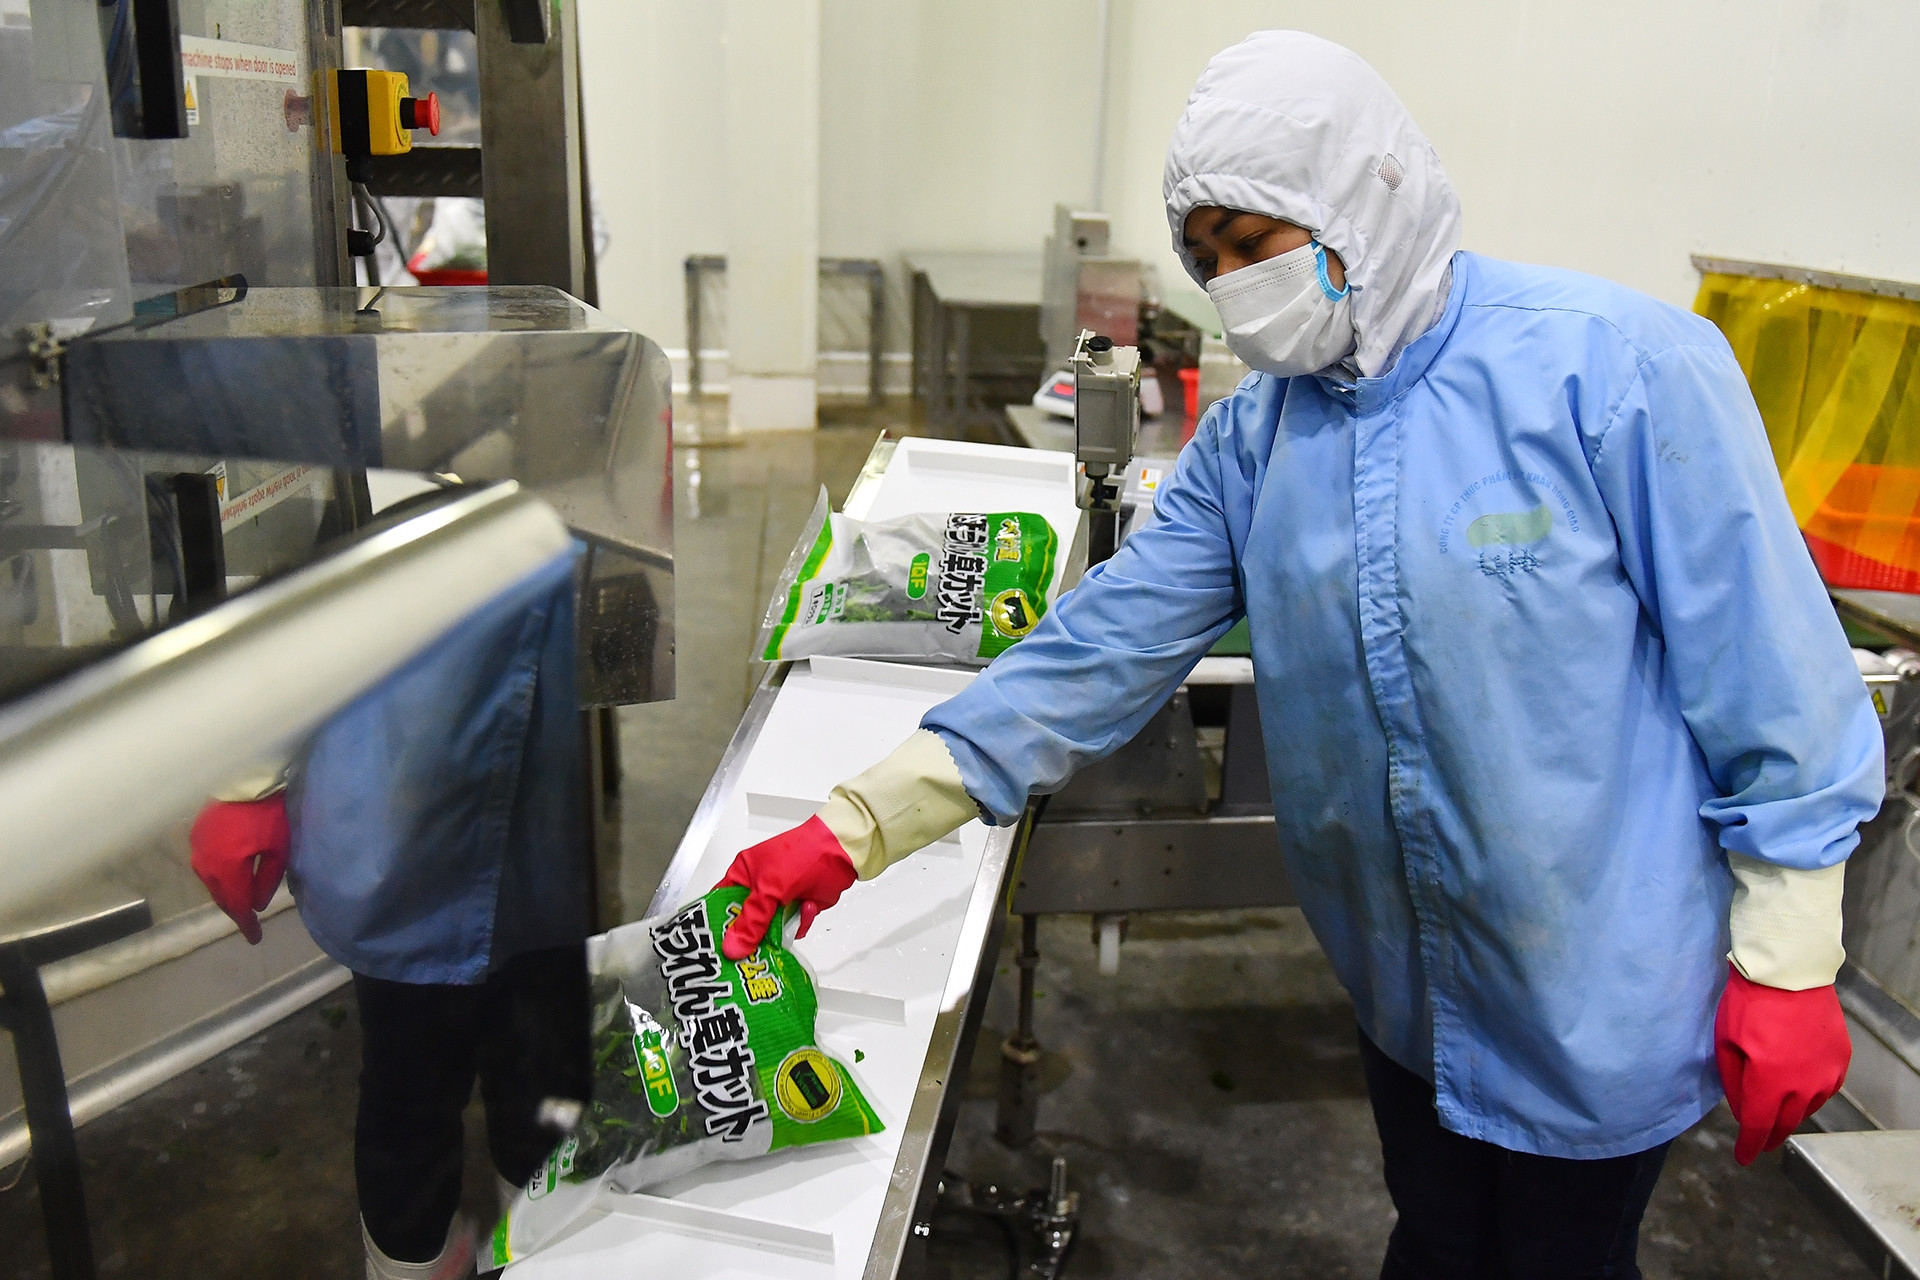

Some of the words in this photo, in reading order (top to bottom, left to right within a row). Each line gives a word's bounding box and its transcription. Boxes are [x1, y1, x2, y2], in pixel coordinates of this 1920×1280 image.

[215, 53, 233, 74] stops
[234, 53, 252, 72] when
[254, 55, 267, 73] door
[269, 58, 274, 74] is
[275, 61, 296, 78] opened
[910, 562, 927, 588] IQF
